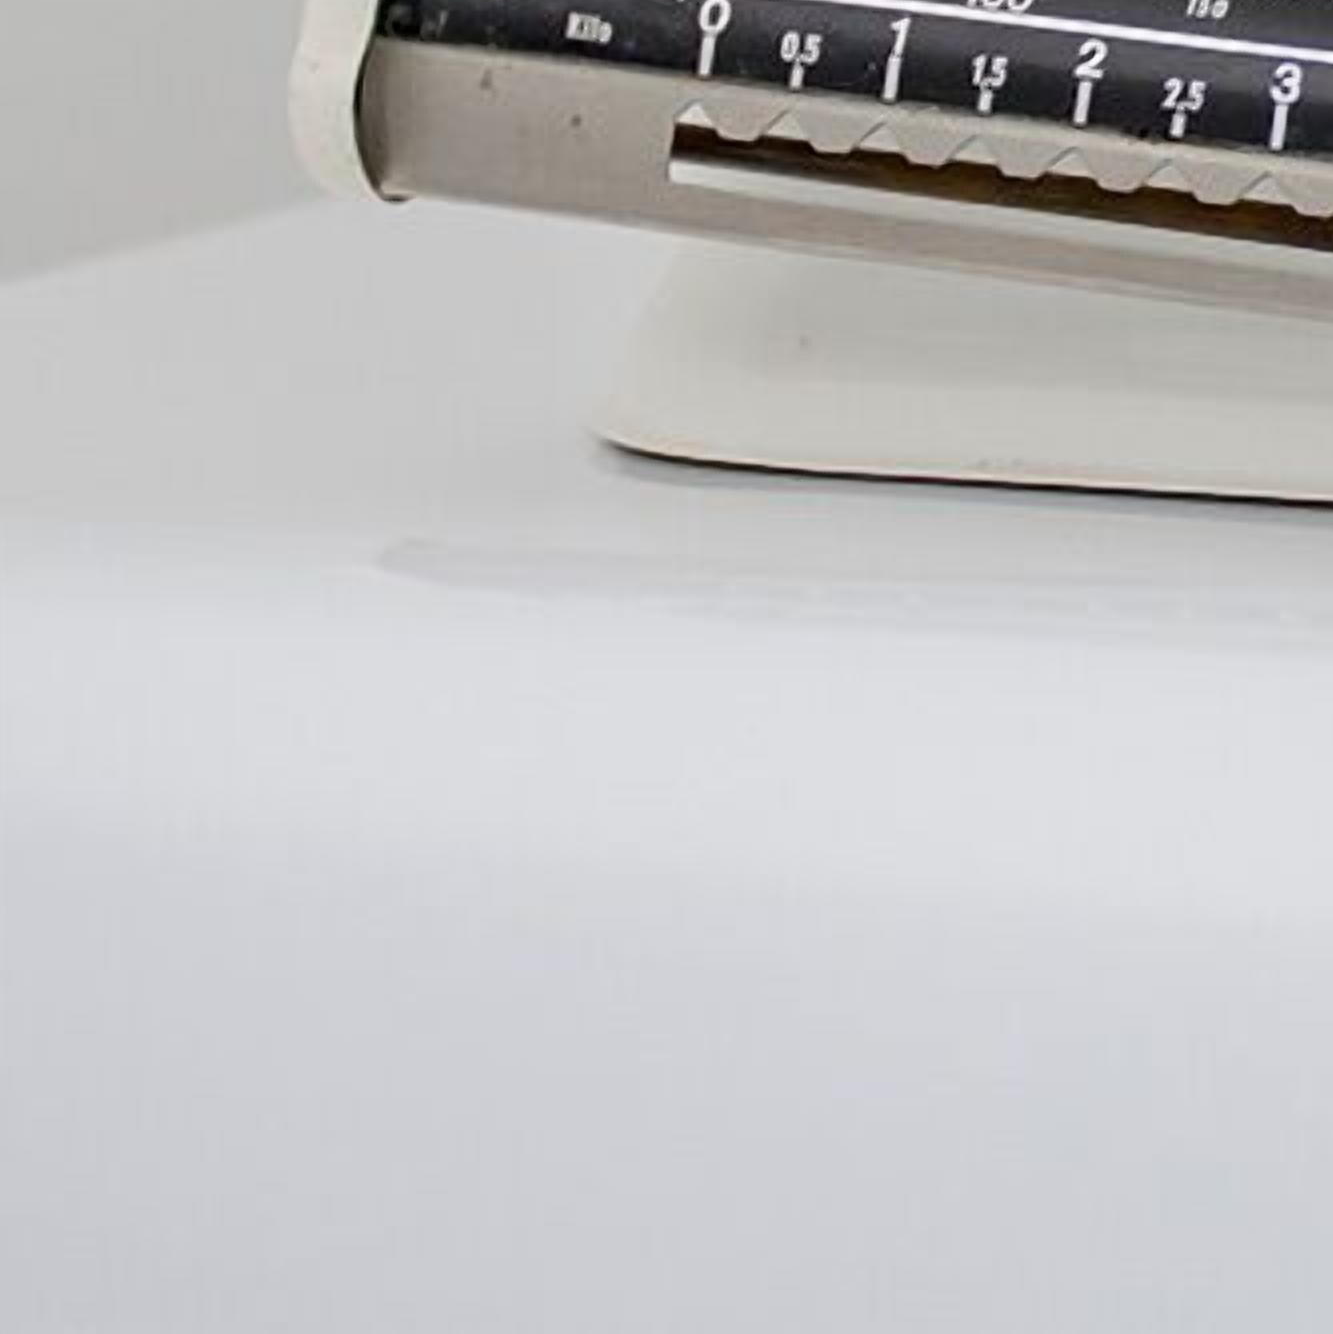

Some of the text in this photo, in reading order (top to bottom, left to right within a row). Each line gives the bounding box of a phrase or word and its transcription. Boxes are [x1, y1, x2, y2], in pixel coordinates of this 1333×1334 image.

[890, 16, 911, 57] 1
[1073, 39, 1109, 79] 2
[1269, 62, 1303, 104] 3
